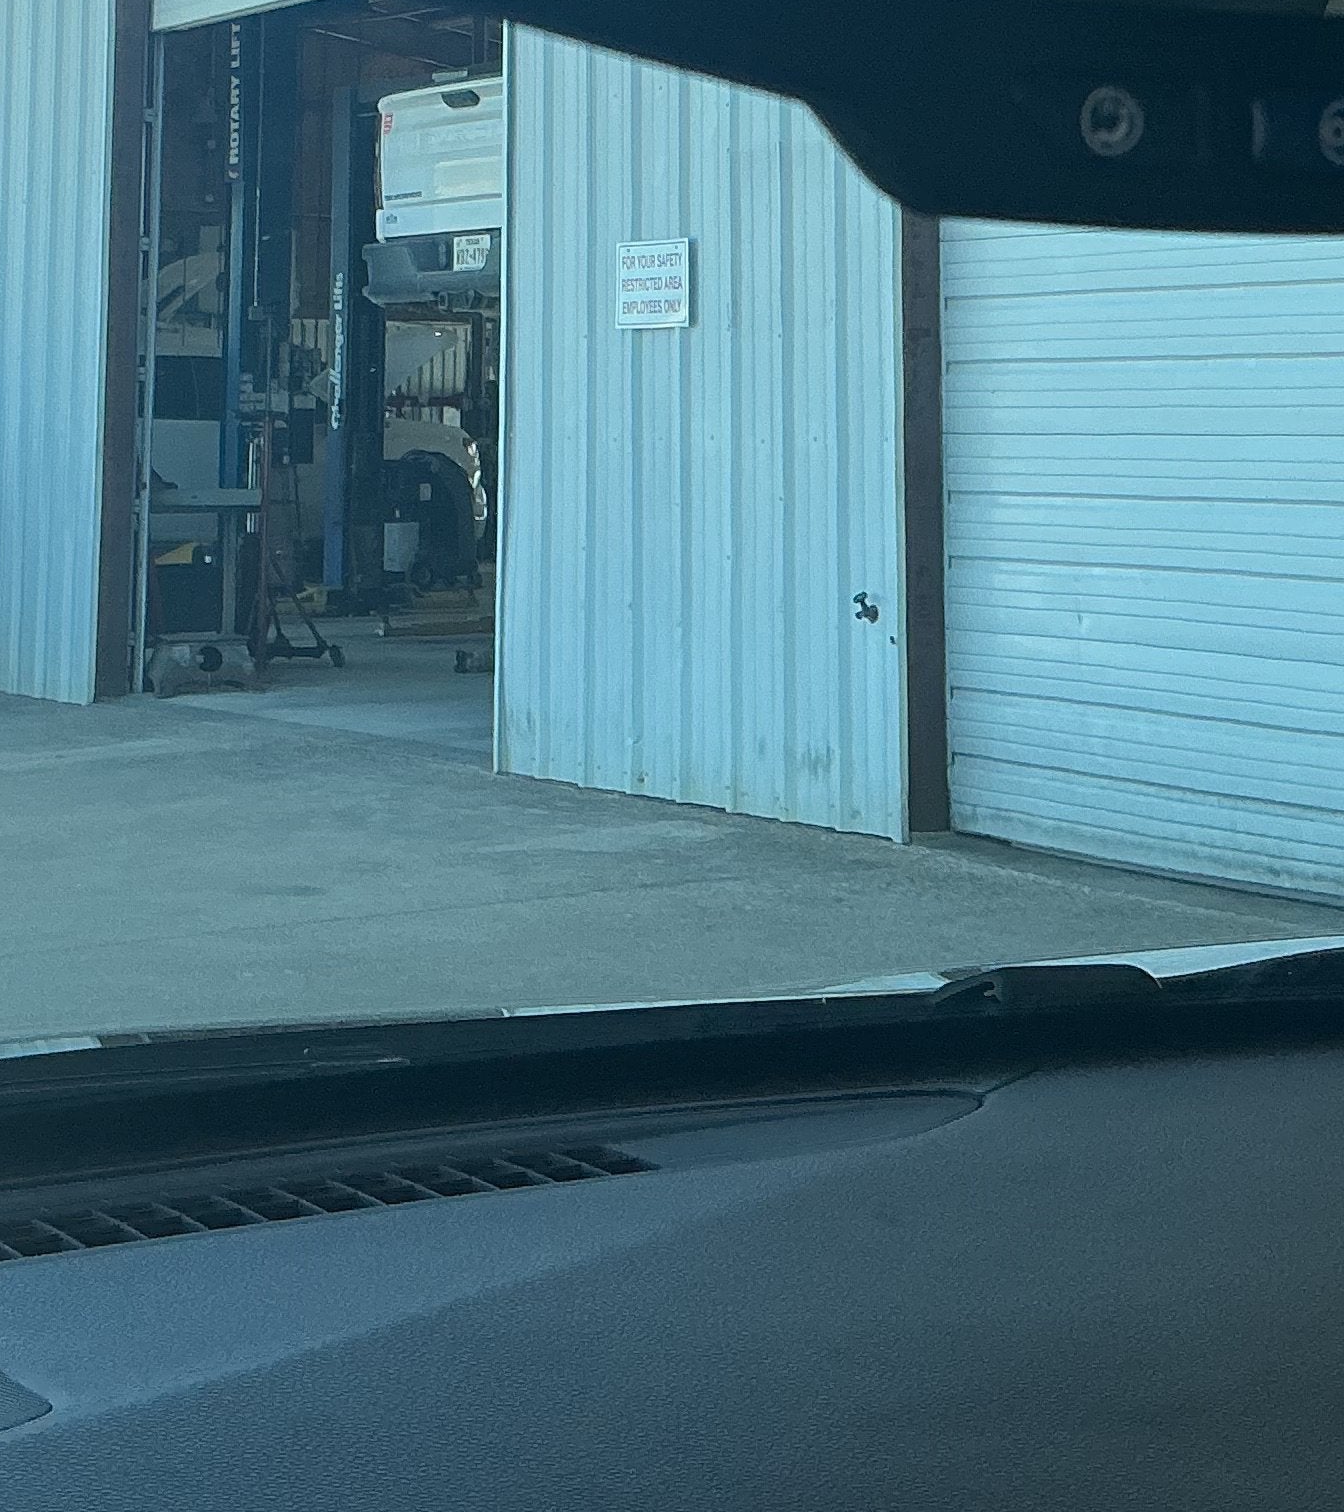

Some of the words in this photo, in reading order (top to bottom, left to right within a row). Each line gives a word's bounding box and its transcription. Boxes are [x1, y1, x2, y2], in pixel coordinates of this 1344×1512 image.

[231, 22, 241, 69] LIFT
[229, 75, 241, 165] ROTARY
[622, 255, 636, 270] FOR
[637, 254, 656, 269] YOUR
[657, 252, 682, 267] SAFETY
[622, 276, 663, 292] RESTRICTED
[664, 275, 683, 290] AREA
[622, 299, 663, 315] EMPLOYEES
[664, 298, 681, 313] ONLY
